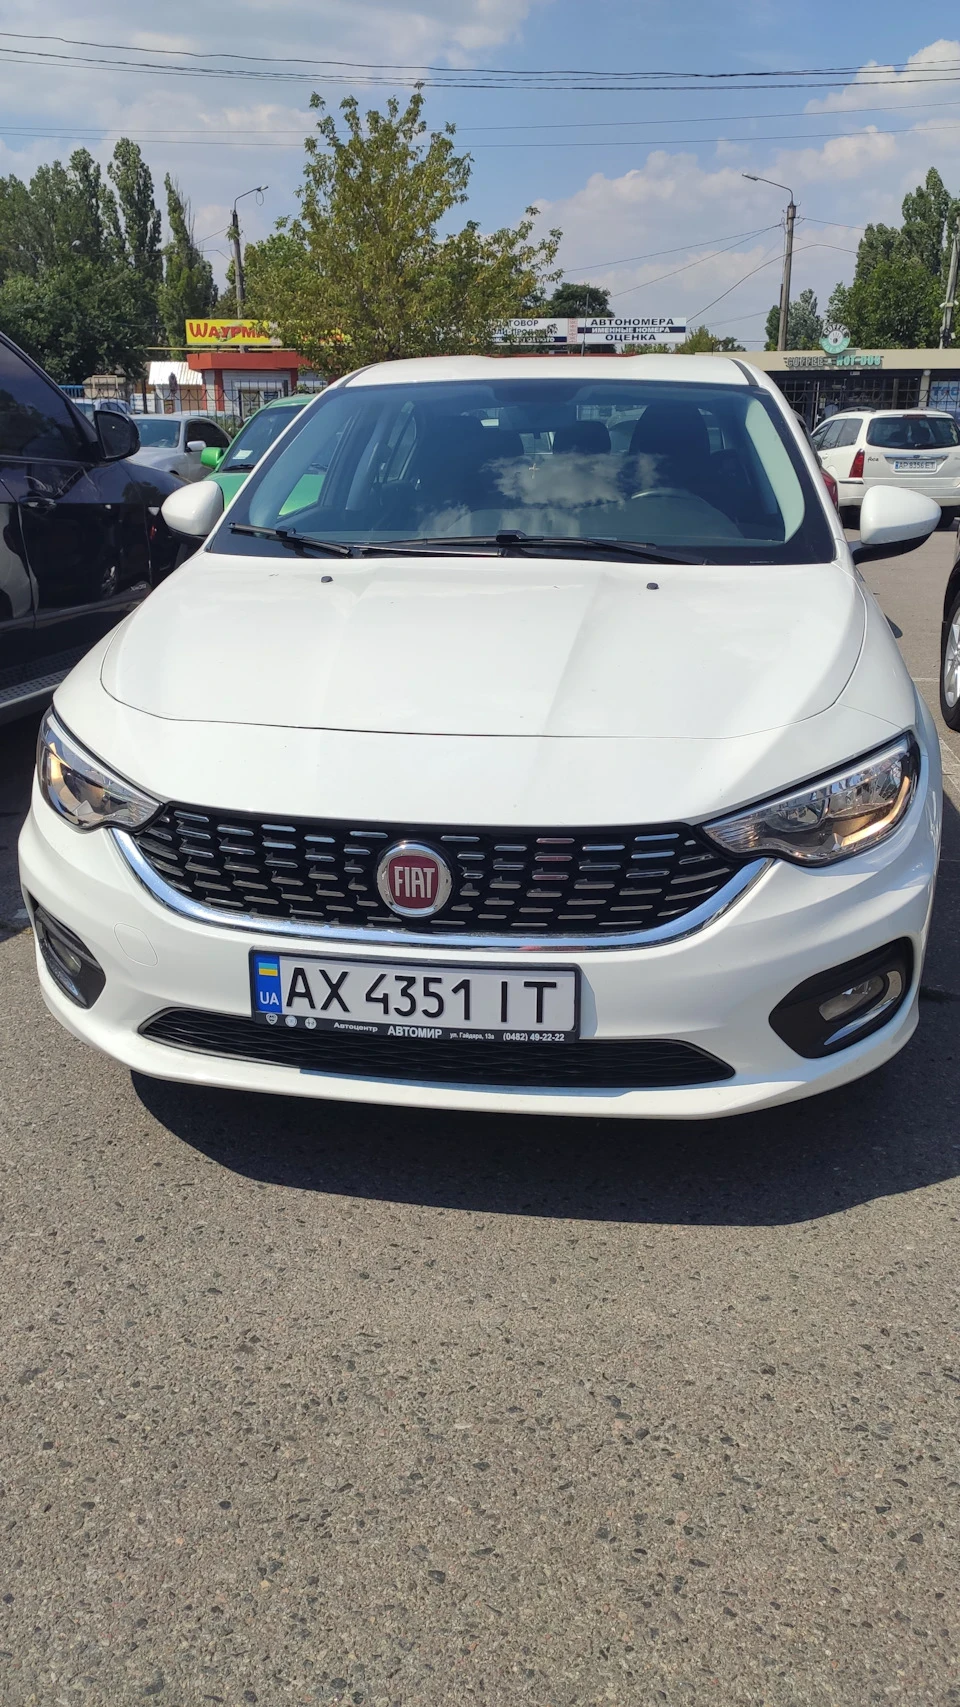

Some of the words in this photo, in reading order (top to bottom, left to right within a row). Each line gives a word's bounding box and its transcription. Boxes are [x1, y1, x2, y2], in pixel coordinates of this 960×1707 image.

[590, 318, 675, 326] АВТОНОМЕРА
[605, 334, 657, 342] ОЦЕНКА
[786, 357, 824, 367] COFFEE
[394, 866, 435, 899] FIAT
[259, 991, 280, 1006] UA
[286, 966, 351, 1013] AX
[365, 973, 471, 1021] 4351
[500, 980, 557, 1024] IT
[333, 1022, 378, 1033] Автоцентр
[387, 1025, 443, 1039] АВТОМИР
[503, 1032, 529, 1042] (0482)
[529, 1033, 565, 1042] 49-22-22
